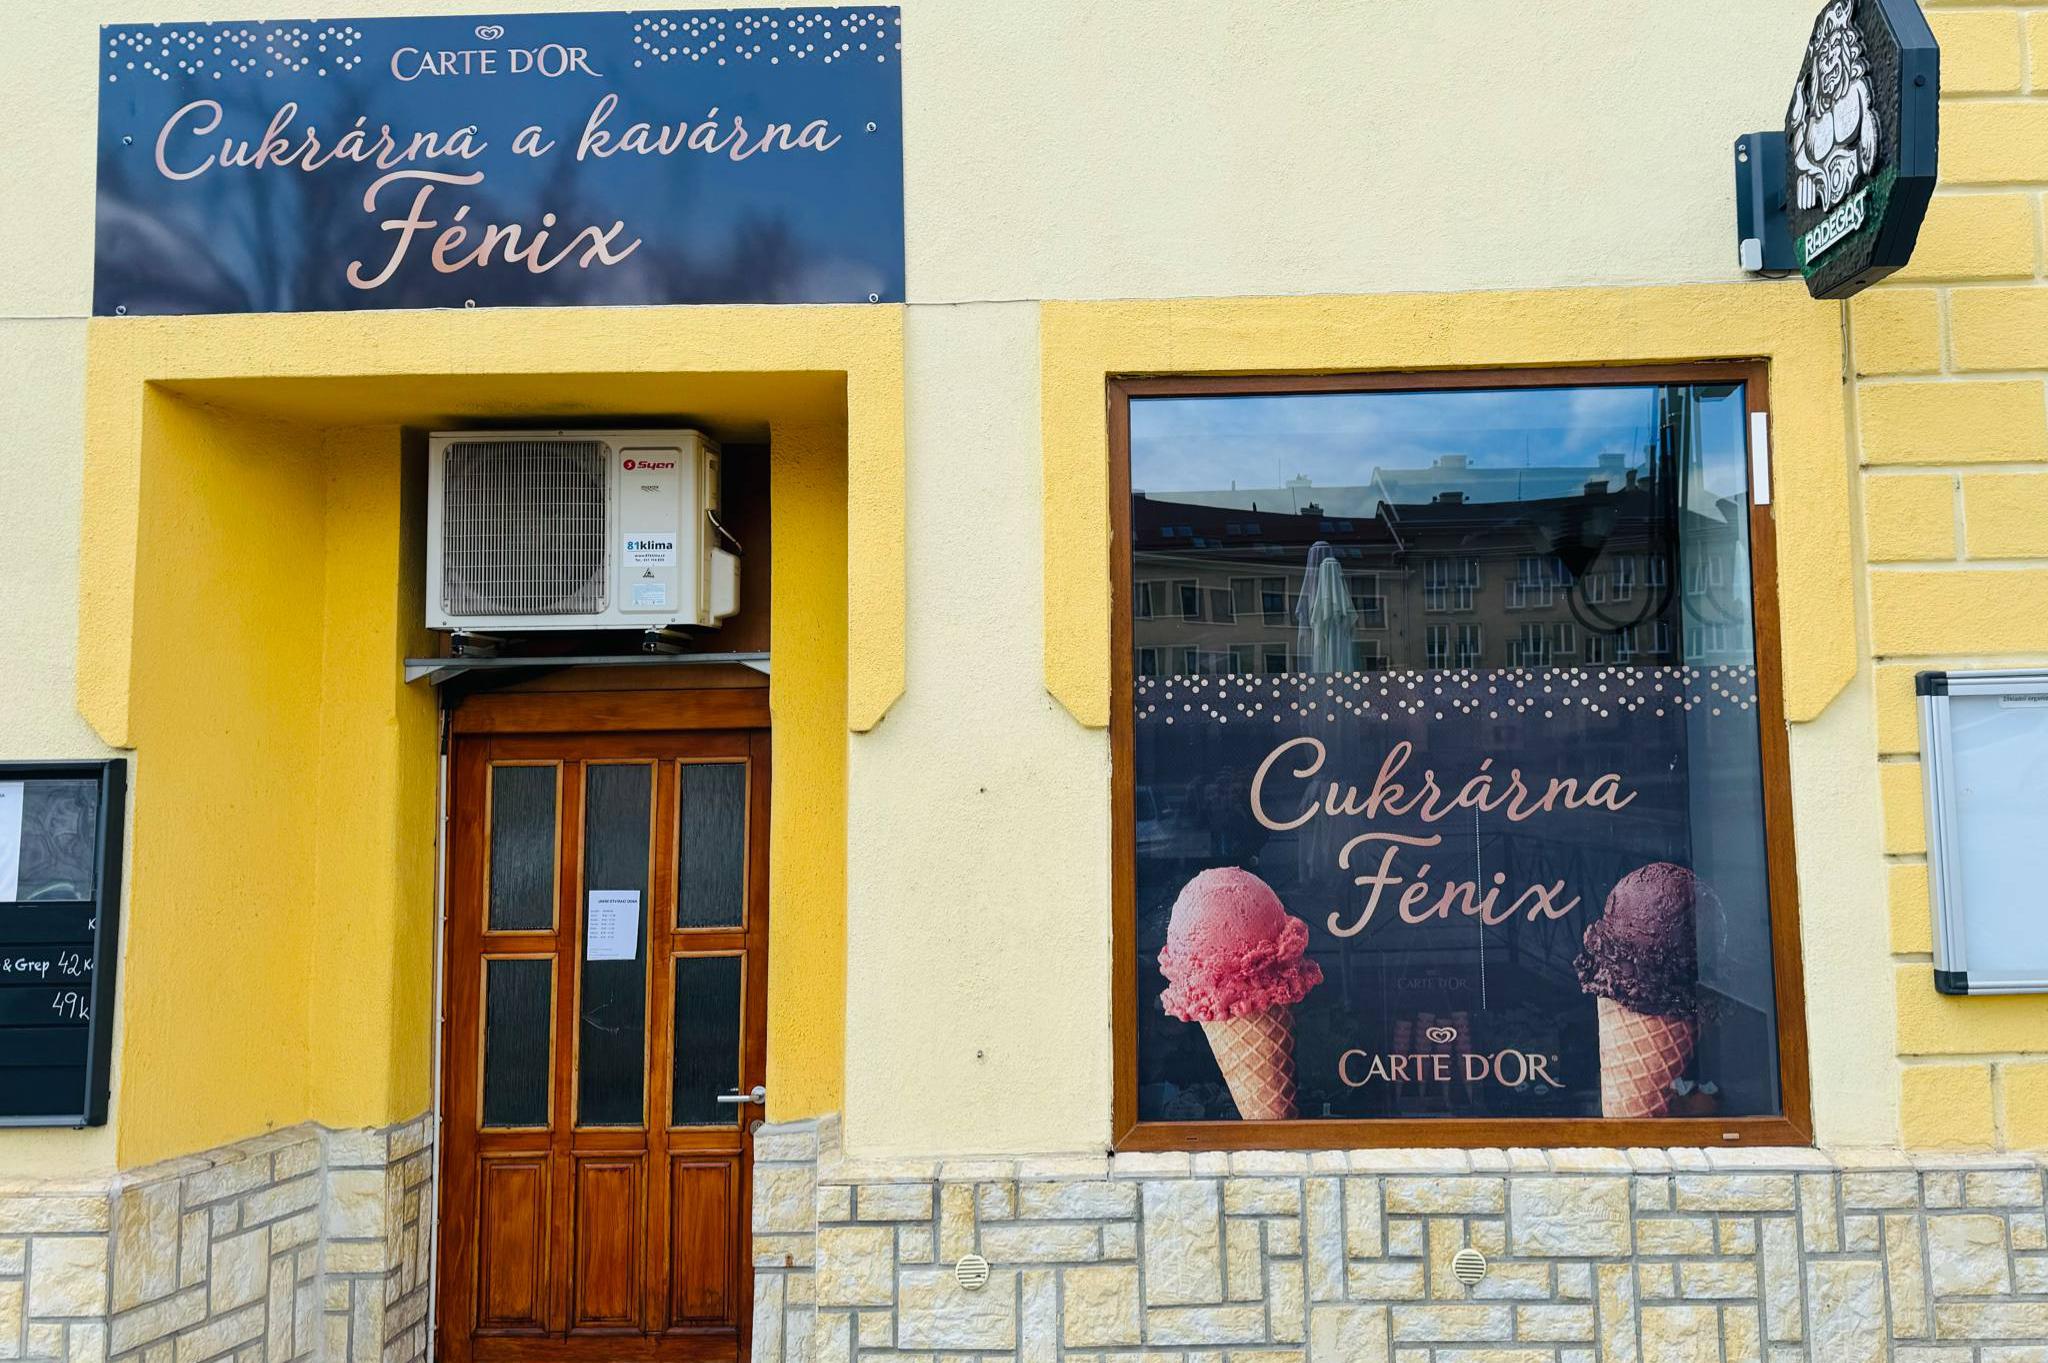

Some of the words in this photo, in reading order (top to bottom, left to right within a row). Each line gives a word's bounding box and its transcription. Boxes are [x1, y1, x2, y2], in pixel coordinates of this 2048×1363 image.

[390, 47, 497, 82] CARTE
[155, 99, 488, 181] Cukrárna
[511, 125, 556, 158] a
[576, 93, 842, 162] kavárna
[346, 169, 642, 290] Fénix
[1804, 187, 1868, 265] RADEGAST
[637, 460, 675, 470] Syen
[627, 540, 673, 550] 81klima
[1250, 736, 1638, 831] Cukrárna
[1326, 832, 1582, 938] Fénix
[3, 958, 12, 972] &
[14, 957, 50, 979] Grep
[58, 950, 81, 976] 42
[1338, 1049, 1451, 1088] CARTE
